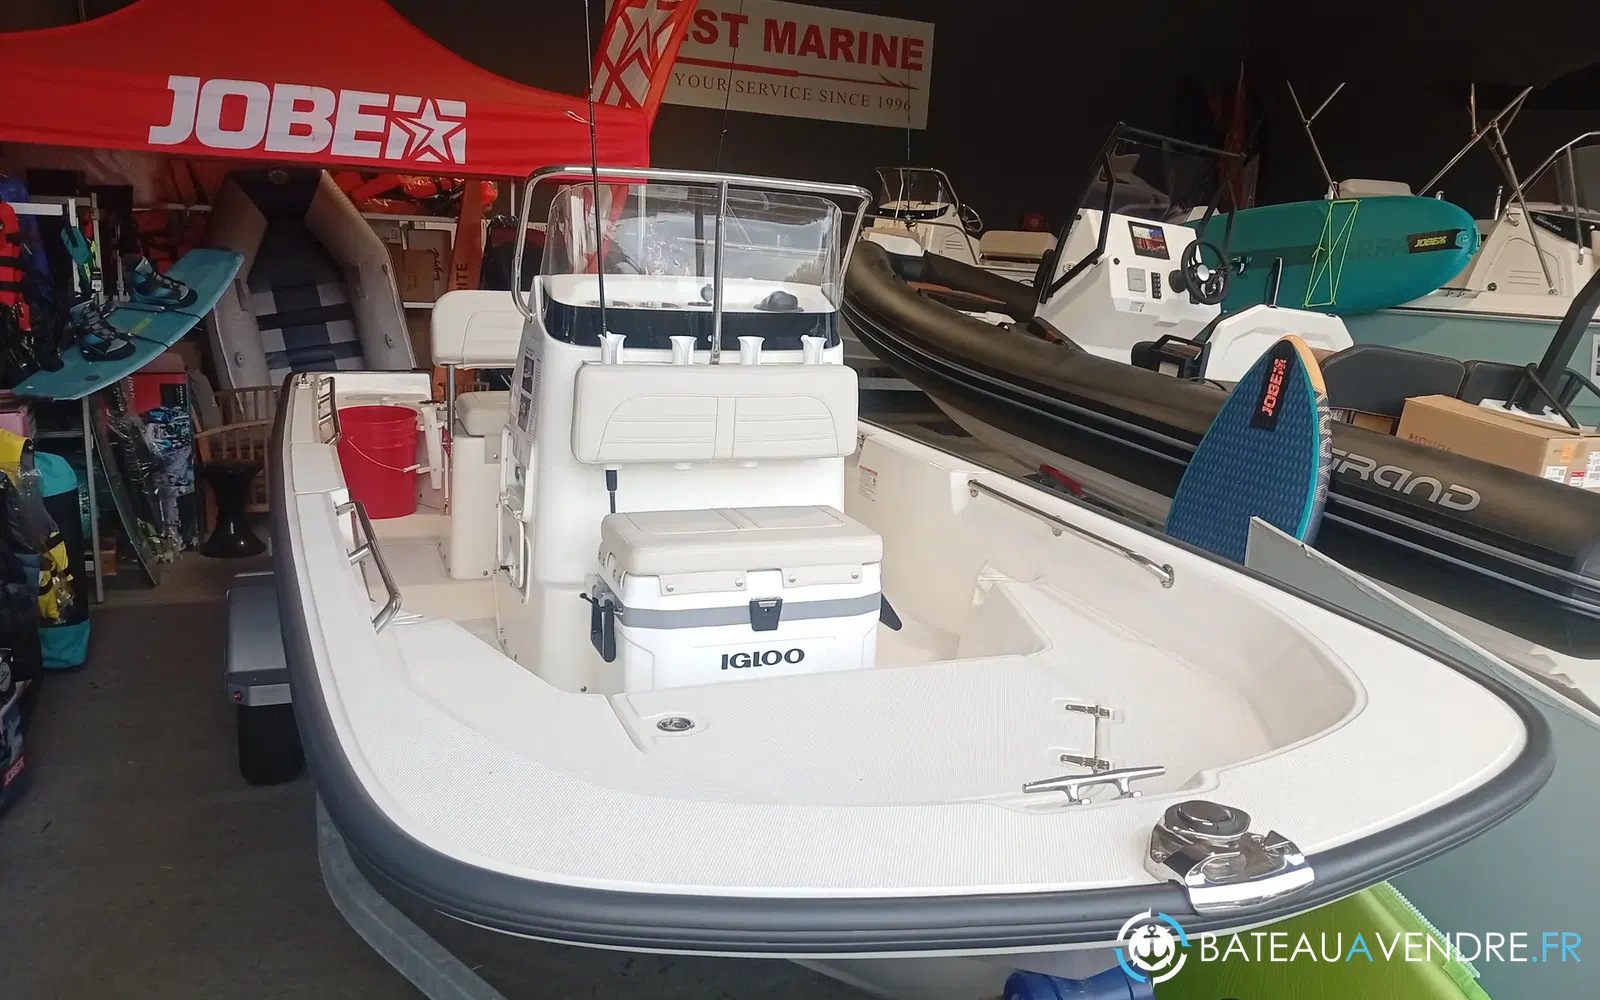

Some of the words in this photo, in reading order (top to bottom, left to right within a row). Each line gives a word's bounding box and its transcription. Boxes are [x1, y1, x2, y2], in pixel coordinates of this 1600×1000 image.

[763, 19, 924, 72] MARINE
[674, 72, 728, 92] YOUR
[735, 79, 813, 101] SERVICE
[819, 90, 870, 108] SINCE
[878, 95, 911, 112] 1996
[148, 75, 390, 159] JOBE
[1414, 236, 1440, 248] JOBE
[1261, 372, 1283, 417] JOBE
[721, 648, 805, 671] IGLOO
